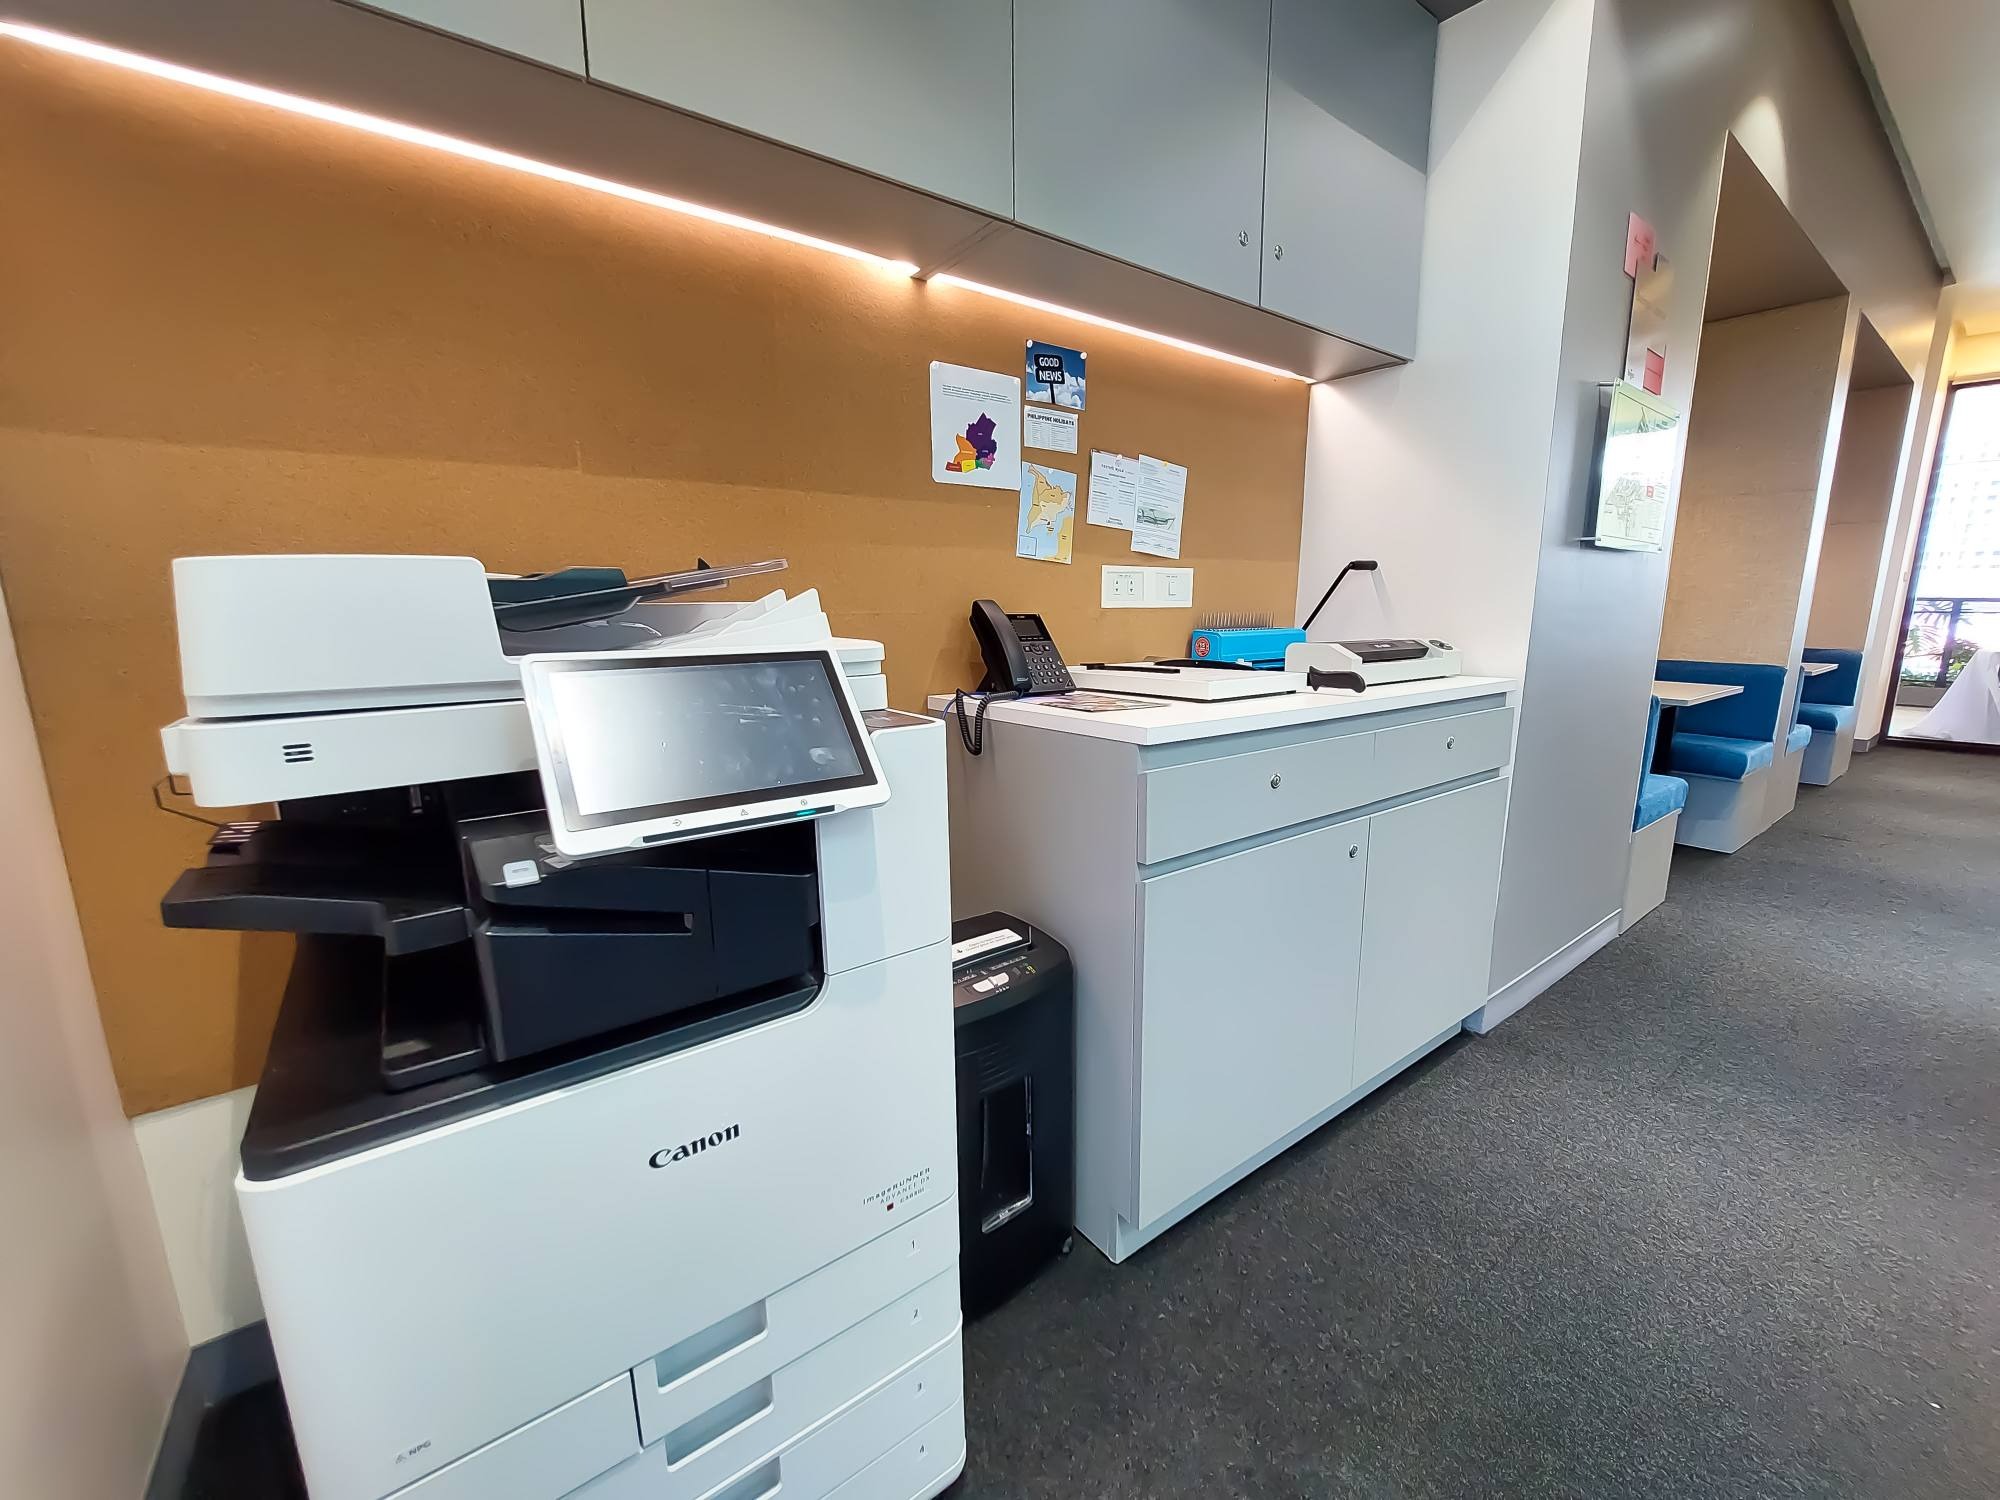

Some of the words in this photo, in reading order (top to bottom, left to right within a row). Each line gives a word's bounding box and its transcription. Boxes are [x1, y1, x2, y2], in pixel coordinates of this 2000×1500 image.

[1039, 357, 1059, 367] GOOD
[1039, 370, 1062, 381] NEWS
[648, 1123, 740, 1169] Canon
